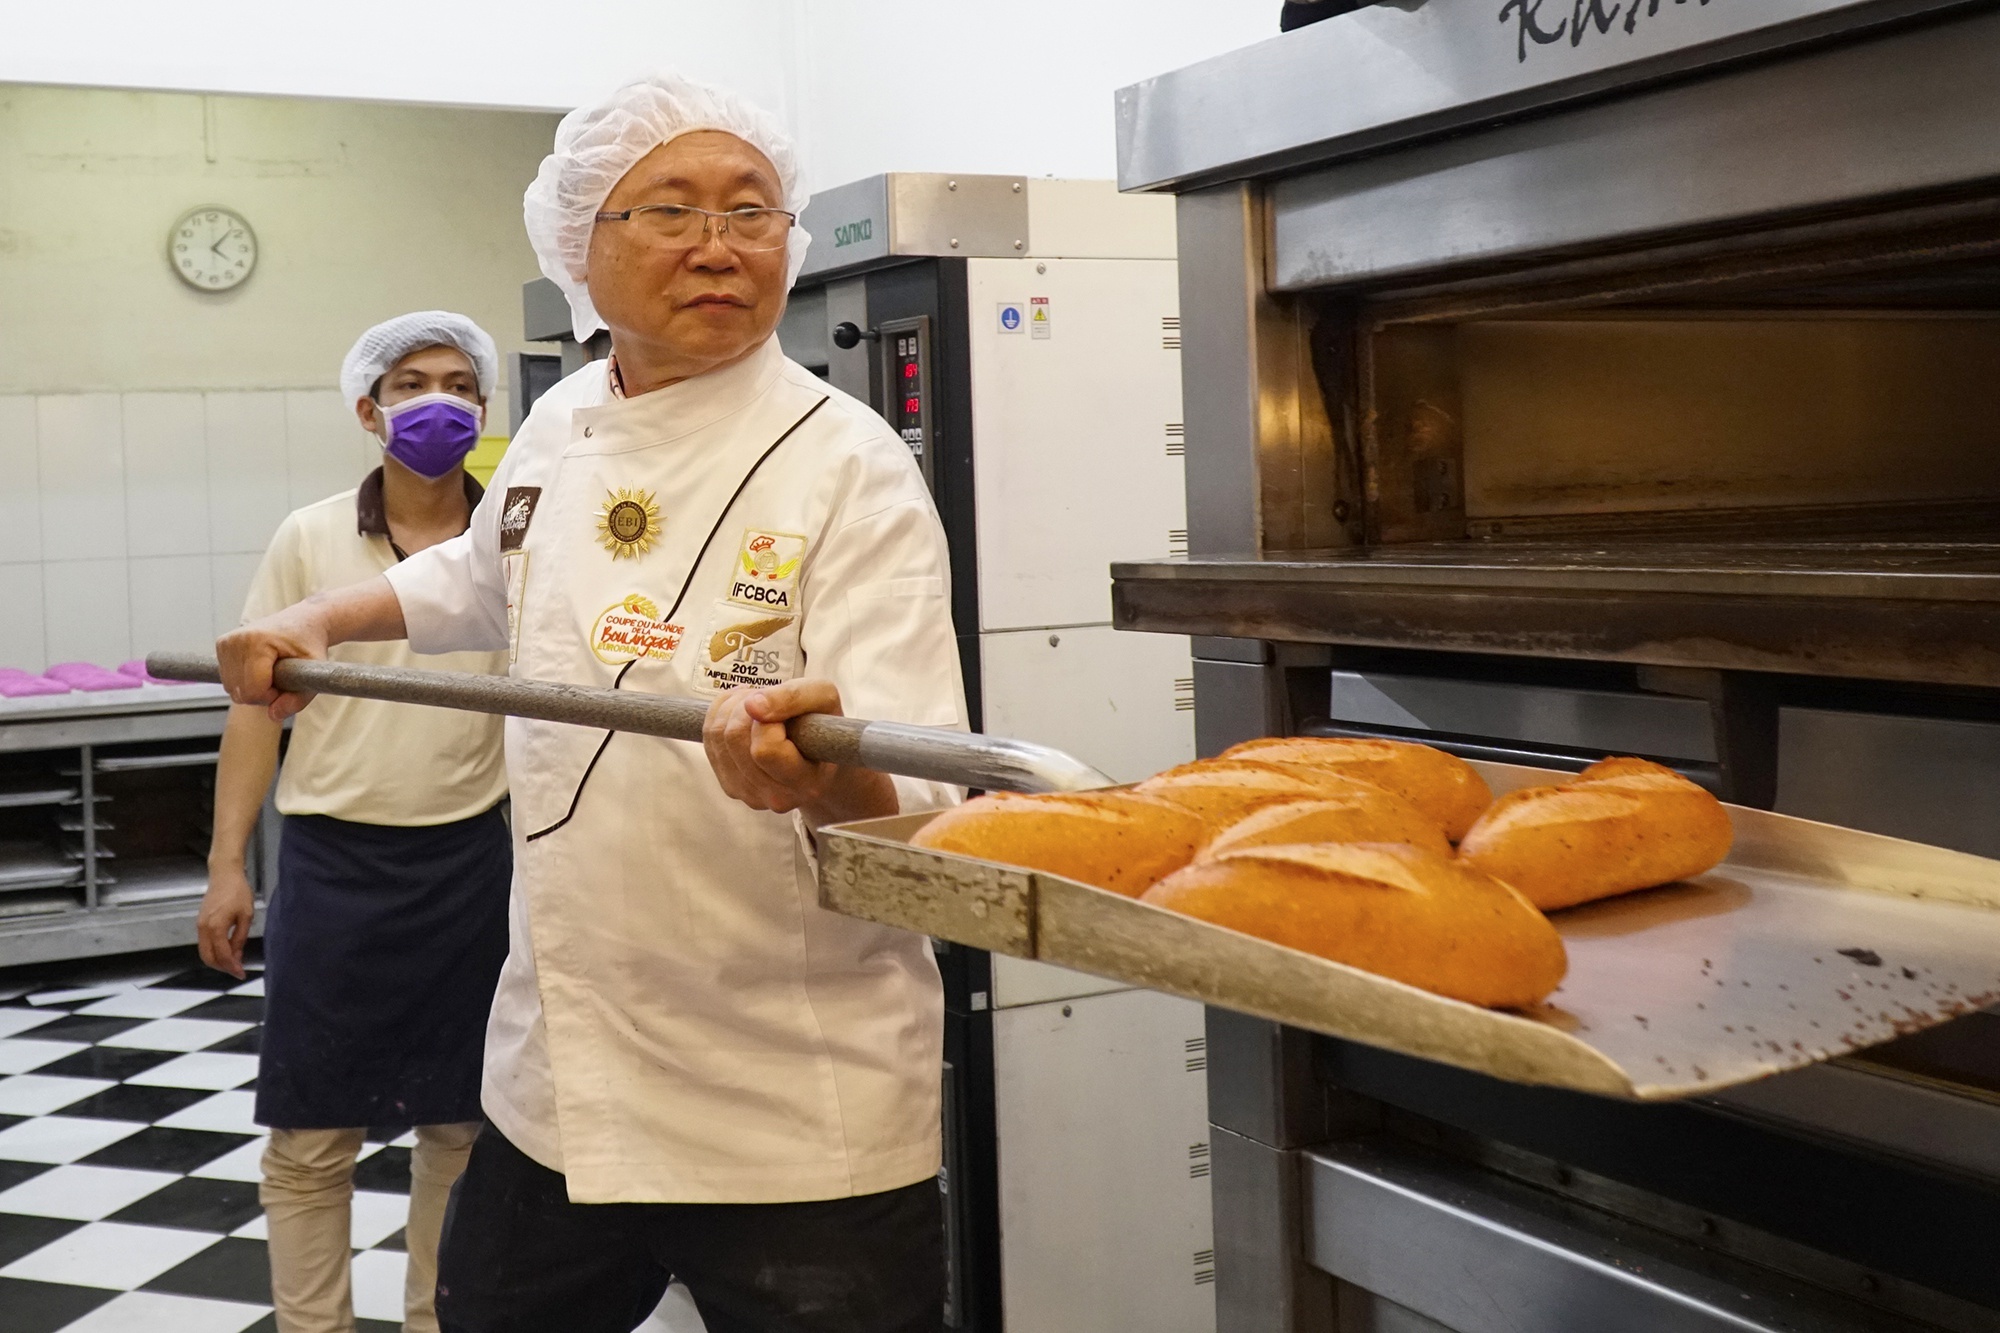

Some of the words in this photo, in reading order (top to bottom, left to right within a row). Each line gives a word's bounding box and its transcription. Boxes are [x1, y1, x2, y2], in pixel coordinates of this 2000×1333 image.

[834, 218, 872, 248] SANKO
[617, 516, 639, 528] EBI
[732, 581, 788, 607] IFCBCA
[606, 615, 637, 627] COUPE
[637, 620, 651, 629] DU
[651, 622, 685, 635] MONDE
[731, 662, 759, 676] 2012
